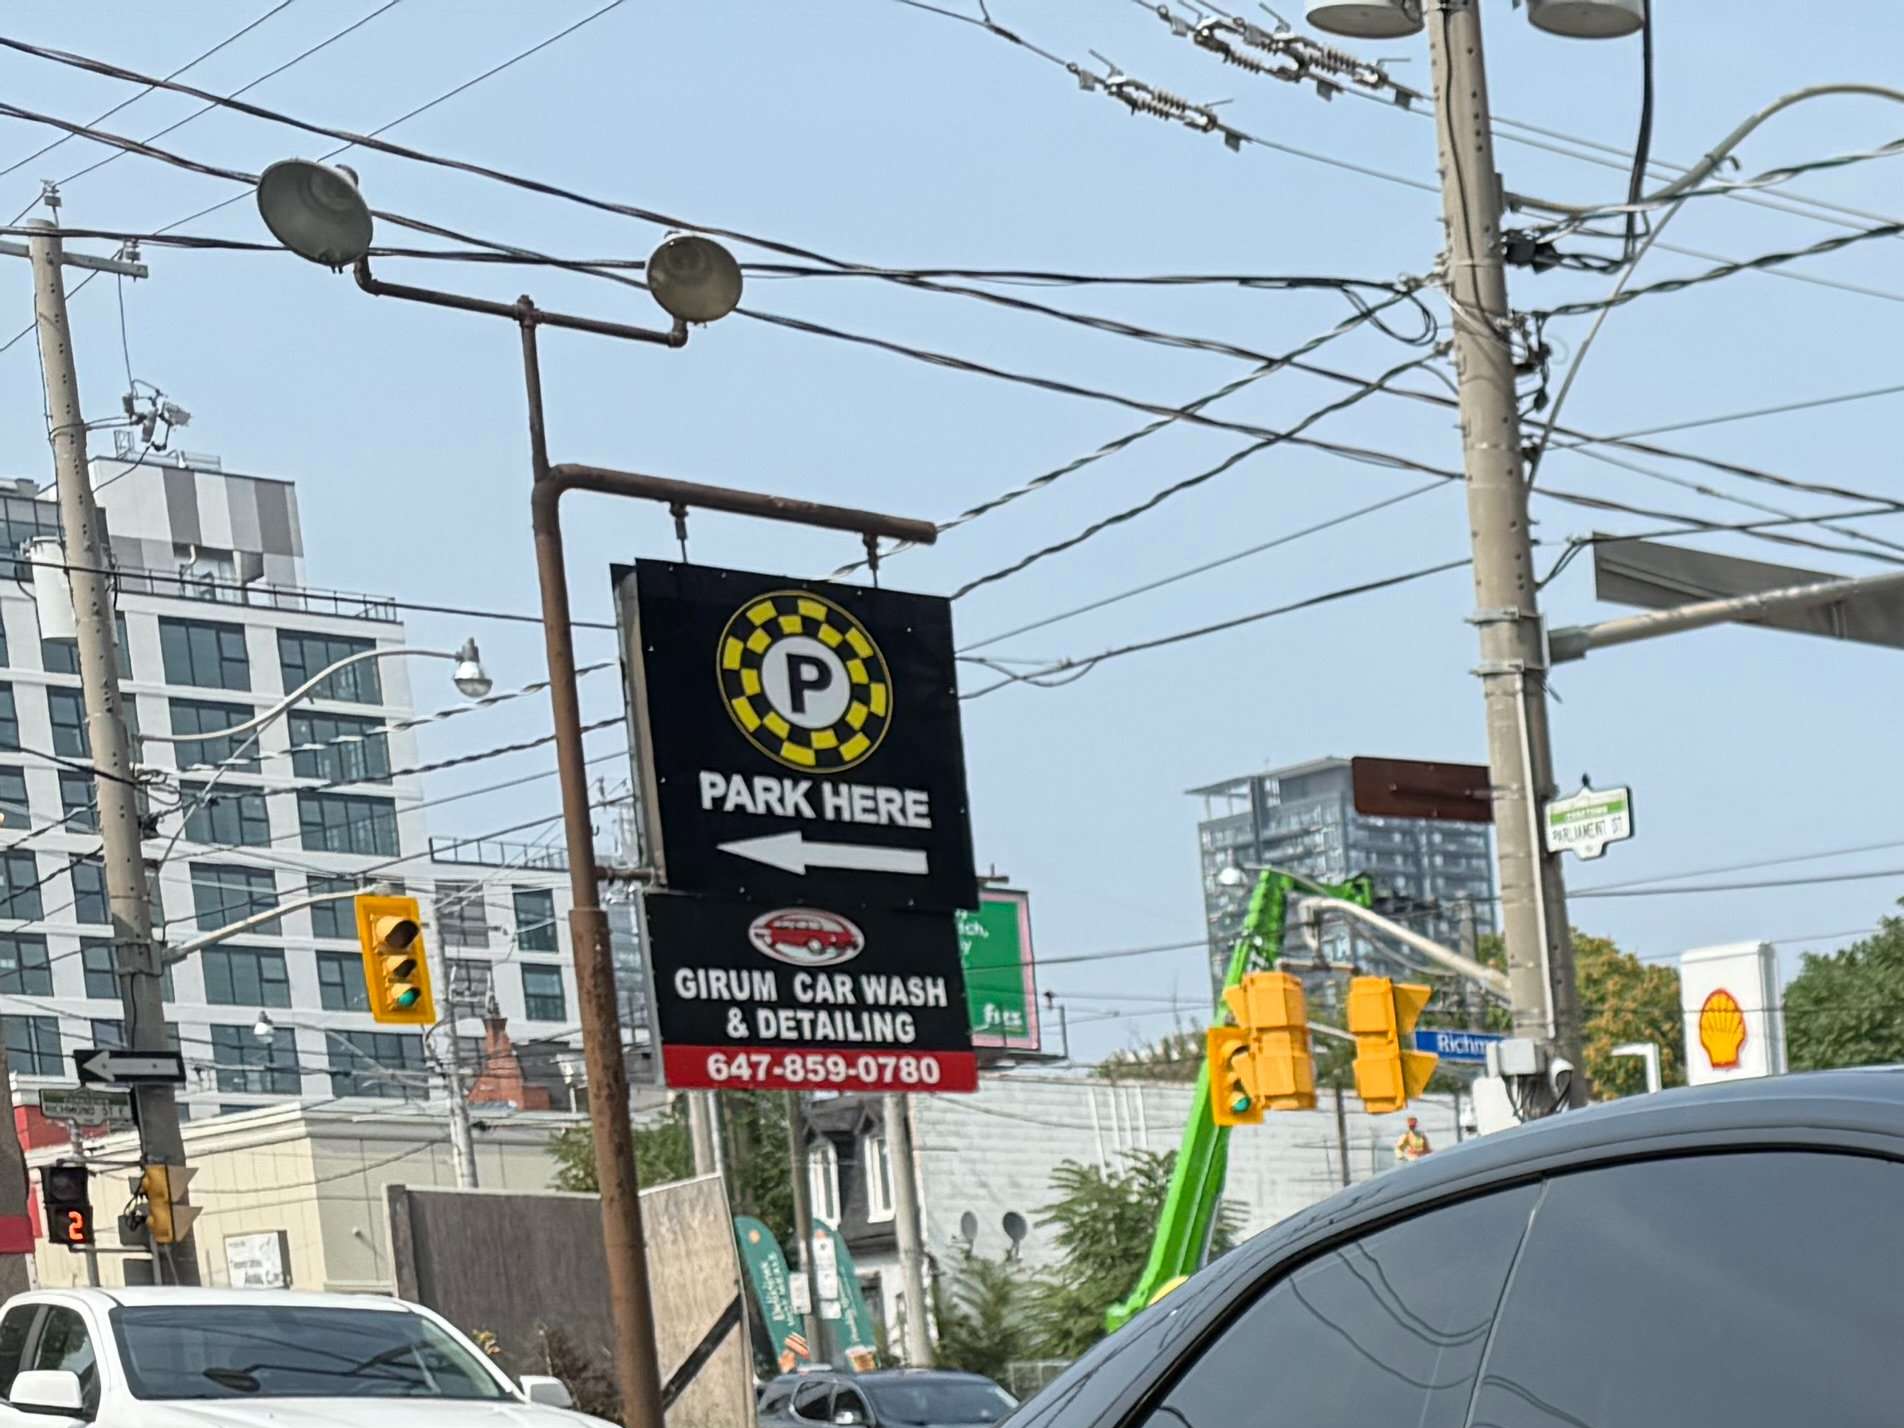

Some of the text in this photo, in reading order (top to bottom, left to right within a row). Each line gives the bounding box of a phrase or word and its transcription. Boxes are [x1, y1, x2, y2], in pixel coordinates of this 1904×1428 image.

[786, 652, 833, 714] P
[700, 770, 932, 829] PARK HERE
[674, 967, 948, 1008] GIRUM CAR WASH
[726, 1006, 916, 1044] & DETAILING
[1437, 1034, 1488, 1056] Richm
[706, 1051, 941, 1086] 647-859-0780
[68, 1210, 85, 1241] 2
